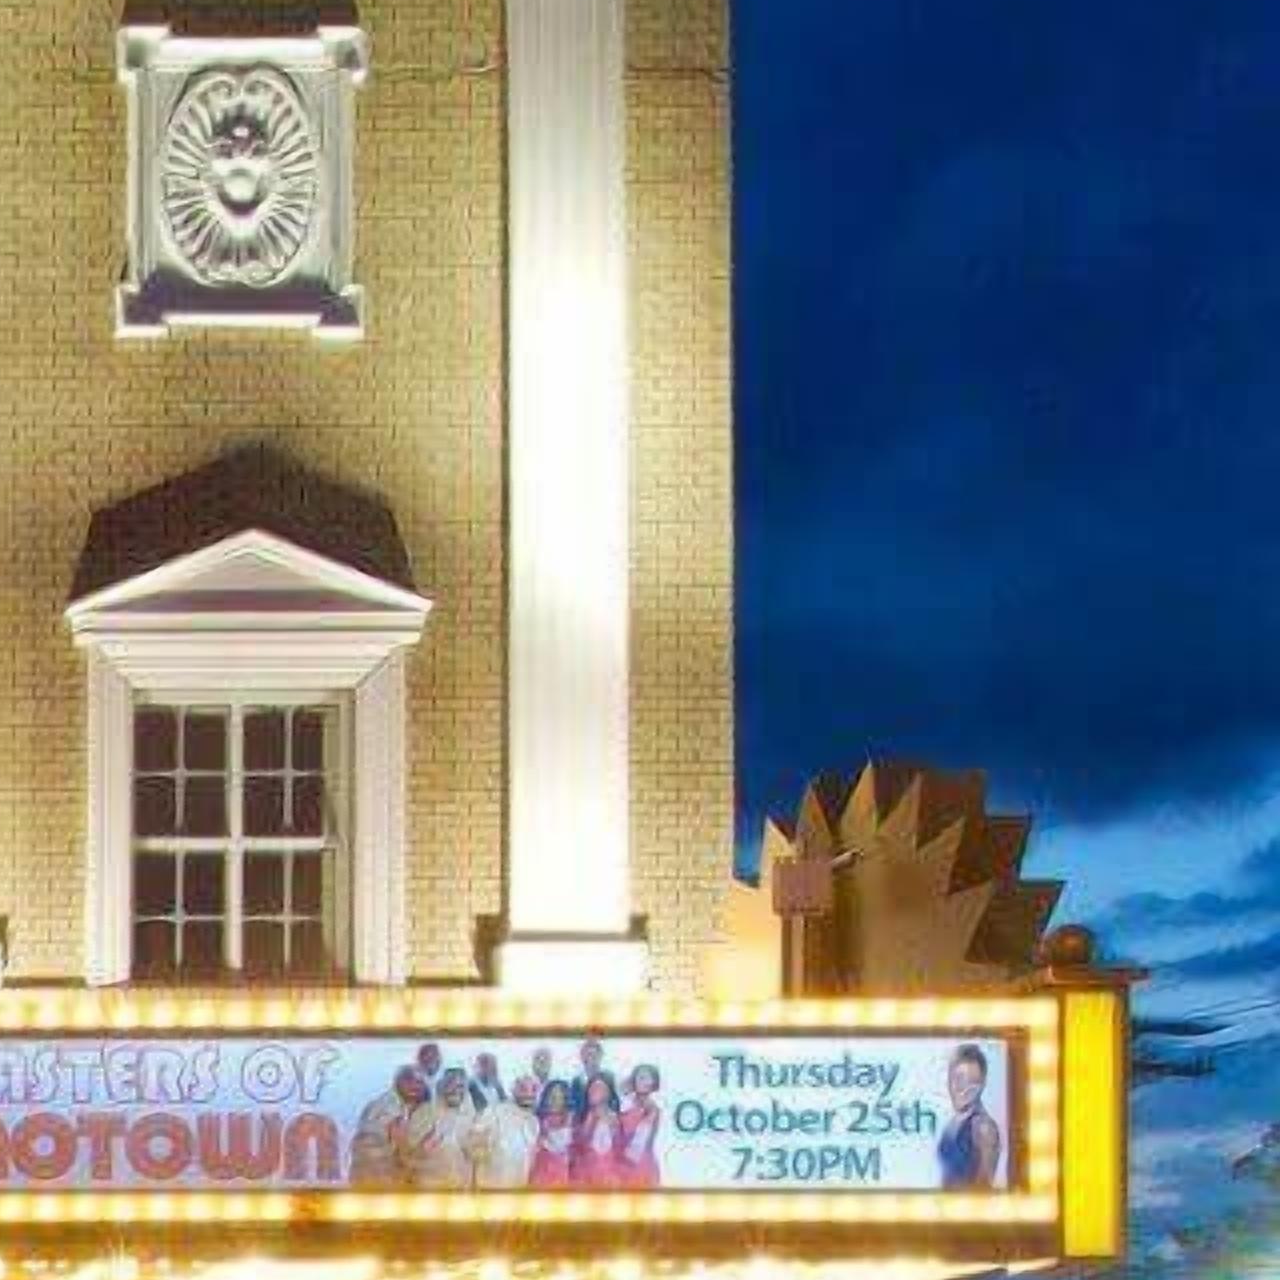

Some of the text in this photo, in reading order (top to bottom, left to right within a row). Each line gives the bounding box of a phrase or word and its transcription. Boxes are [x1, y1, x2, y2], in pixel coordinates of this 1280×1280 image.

[240, 1043, 340, 1104] OF
[710, 1054, 900, 1094] Thursday
[674, 1099, 938, 1134] October 25th
[731, 1147, 882, 1180] 7:30PM
